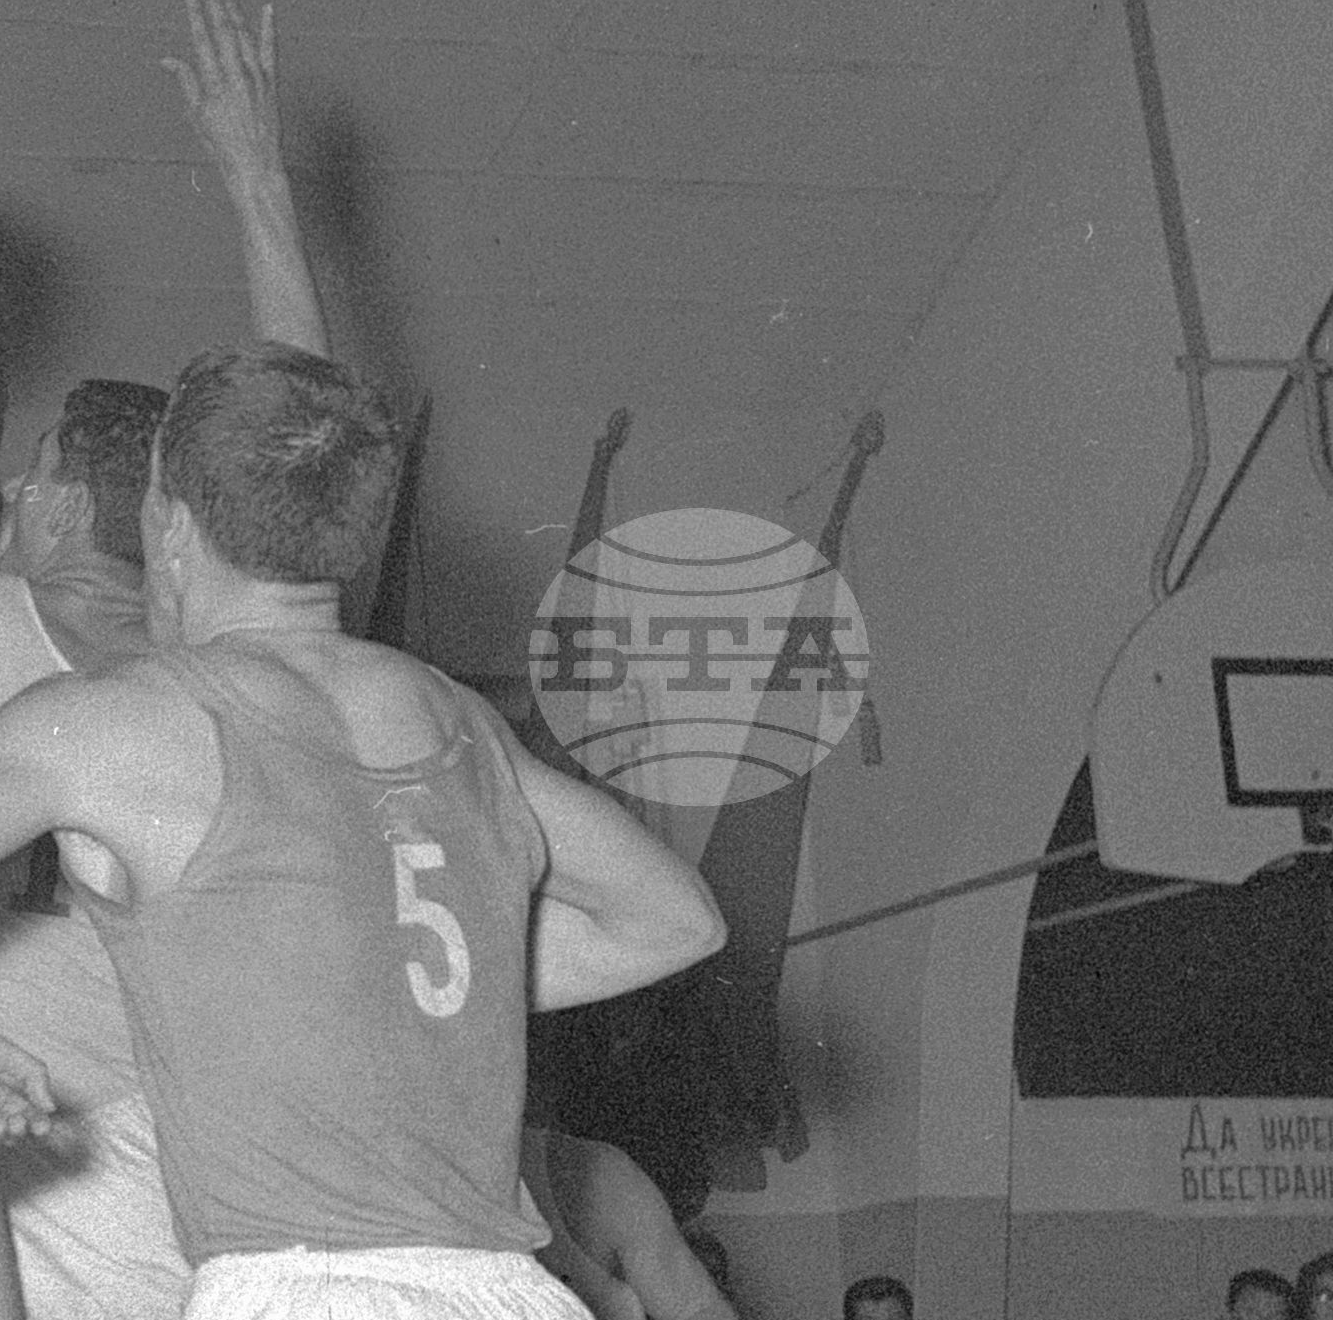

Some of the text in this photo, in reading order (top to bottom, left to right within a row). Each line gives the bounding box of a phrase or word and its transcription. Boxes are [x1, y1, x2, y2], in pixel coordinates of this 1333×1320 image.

[394, 844, 470, 1017] 5
[1260, 1115, 1333, 1151] УКРЕ
[1182, 1165, 1333, 1199] ВСЕСТРАН
